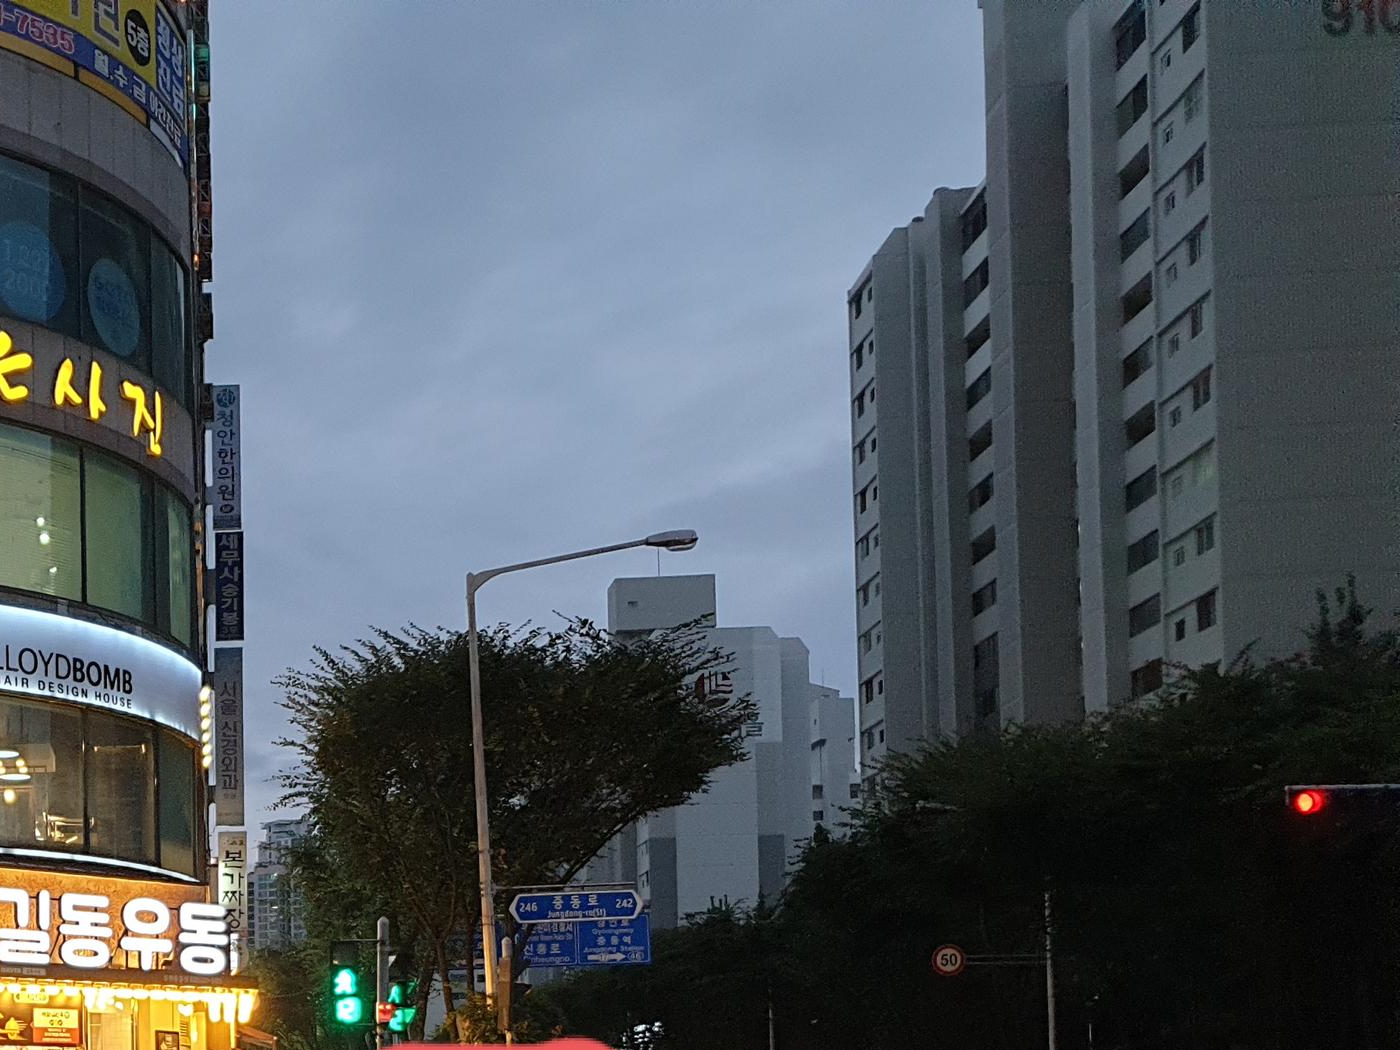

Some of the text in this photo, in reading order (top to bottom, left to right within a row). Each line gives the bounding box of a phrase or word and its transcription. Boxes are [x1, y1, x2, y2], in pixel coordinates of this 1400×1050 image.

[38, 680, 88, 699] DESIGN
[94, 691, 132, 709] HOUSE
[519, 894, 634, 913] 246 중동로 242
[940, 953, 958, 967] 50
